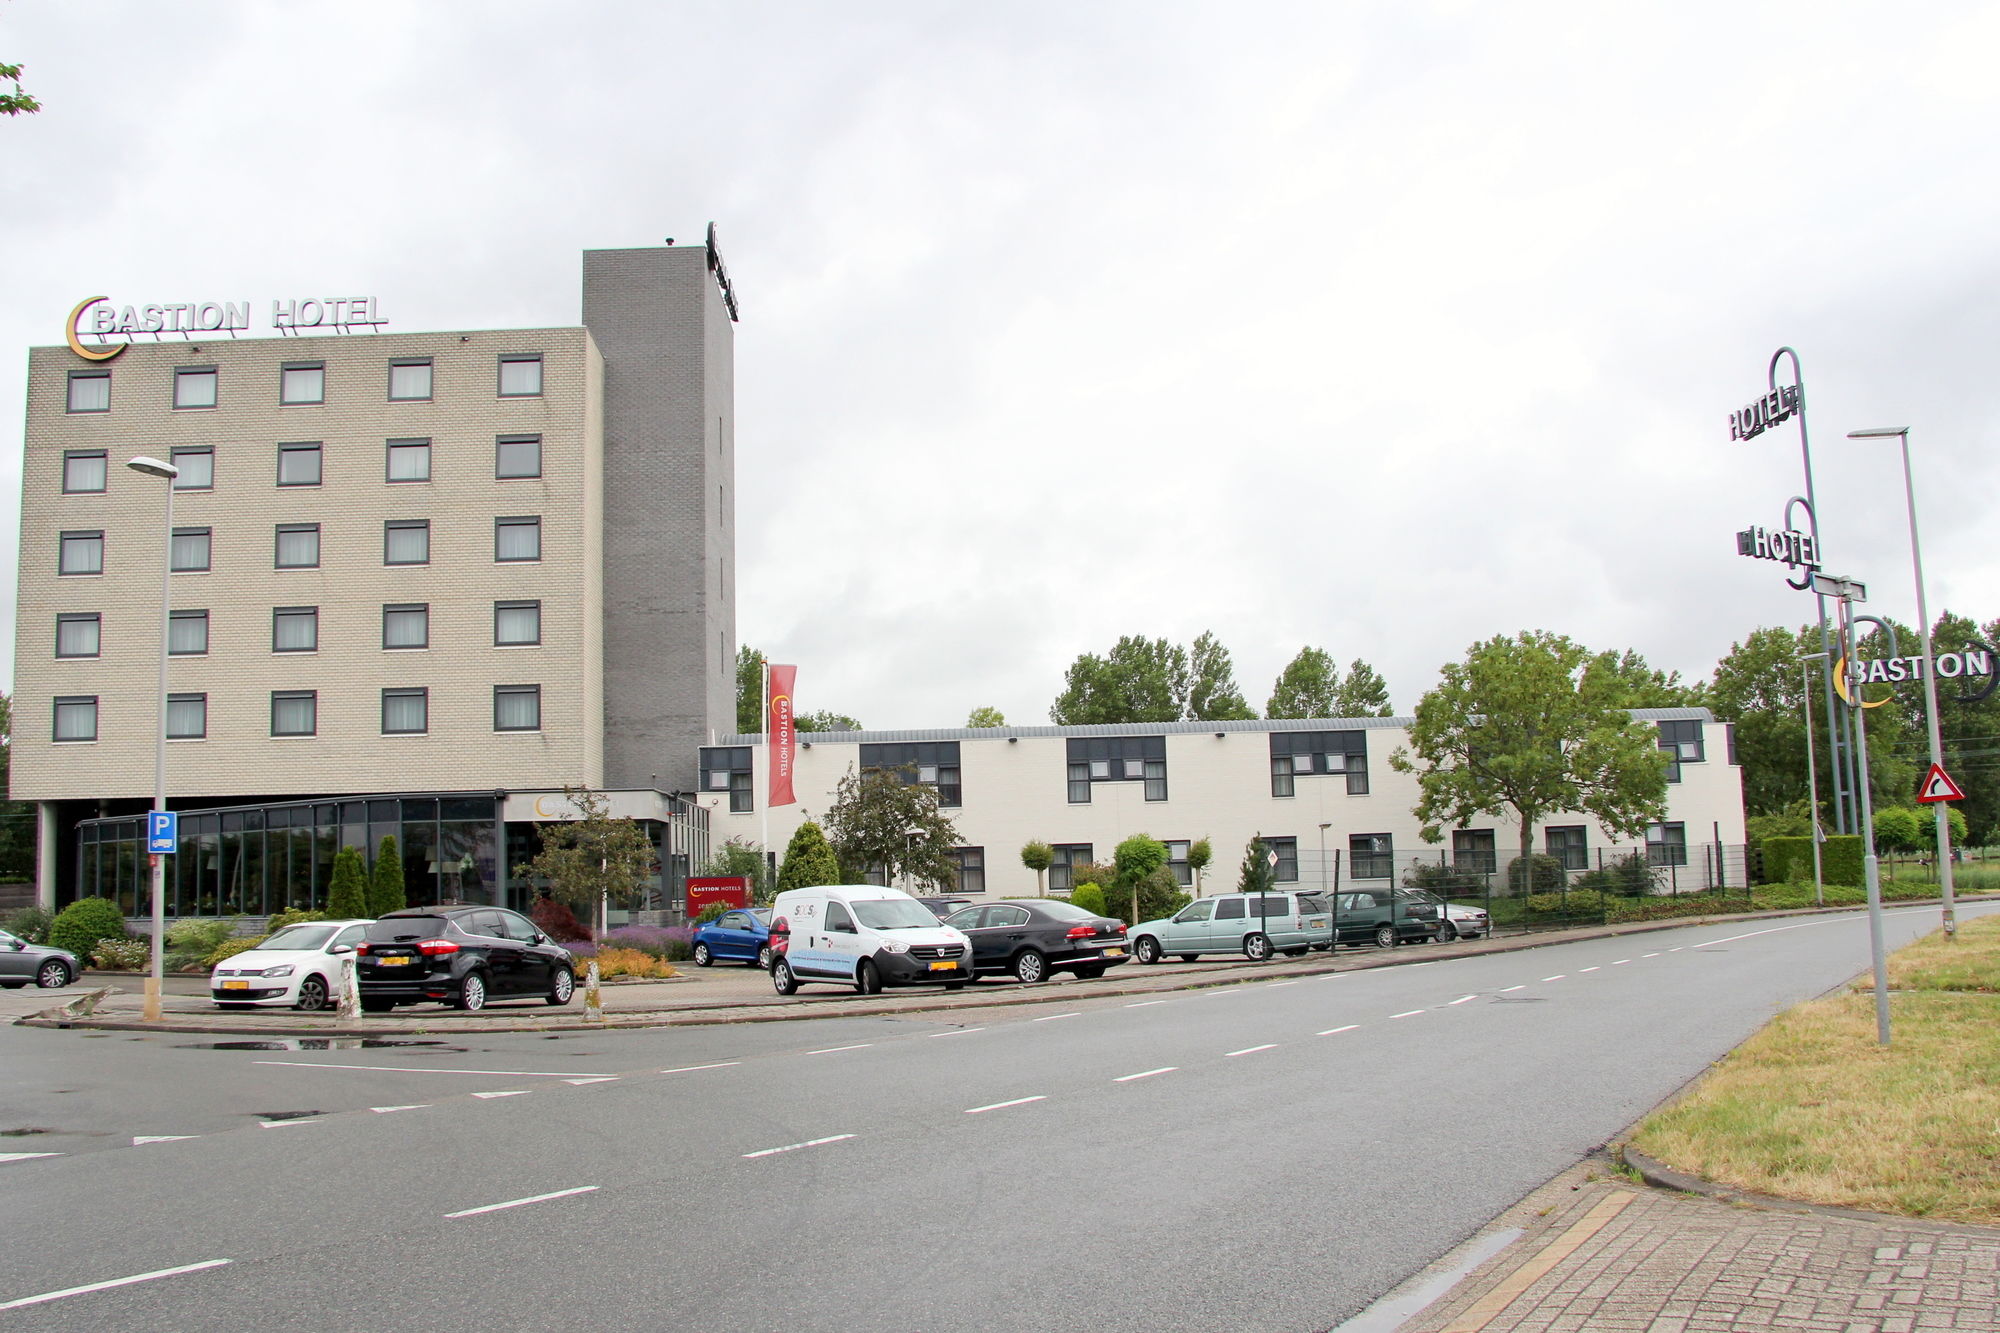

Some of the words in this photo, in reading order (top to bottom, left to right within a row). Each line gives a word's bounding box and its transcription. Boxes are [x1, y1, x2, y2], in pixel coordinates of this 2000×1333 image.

[91, 301, 250, 334] BASTION
[272, 296, 389, 328] HOTEL
[1728, 386, 1790, 441] HOTEL
[1753, 525, 1823, 567] HOTEL
[1848, 650, 1989, 684] BASTON
[780, 700, 789, 744] BASTION
[780, 747, 788, 777] HOTELS
[155, 815, 170, 835] P
